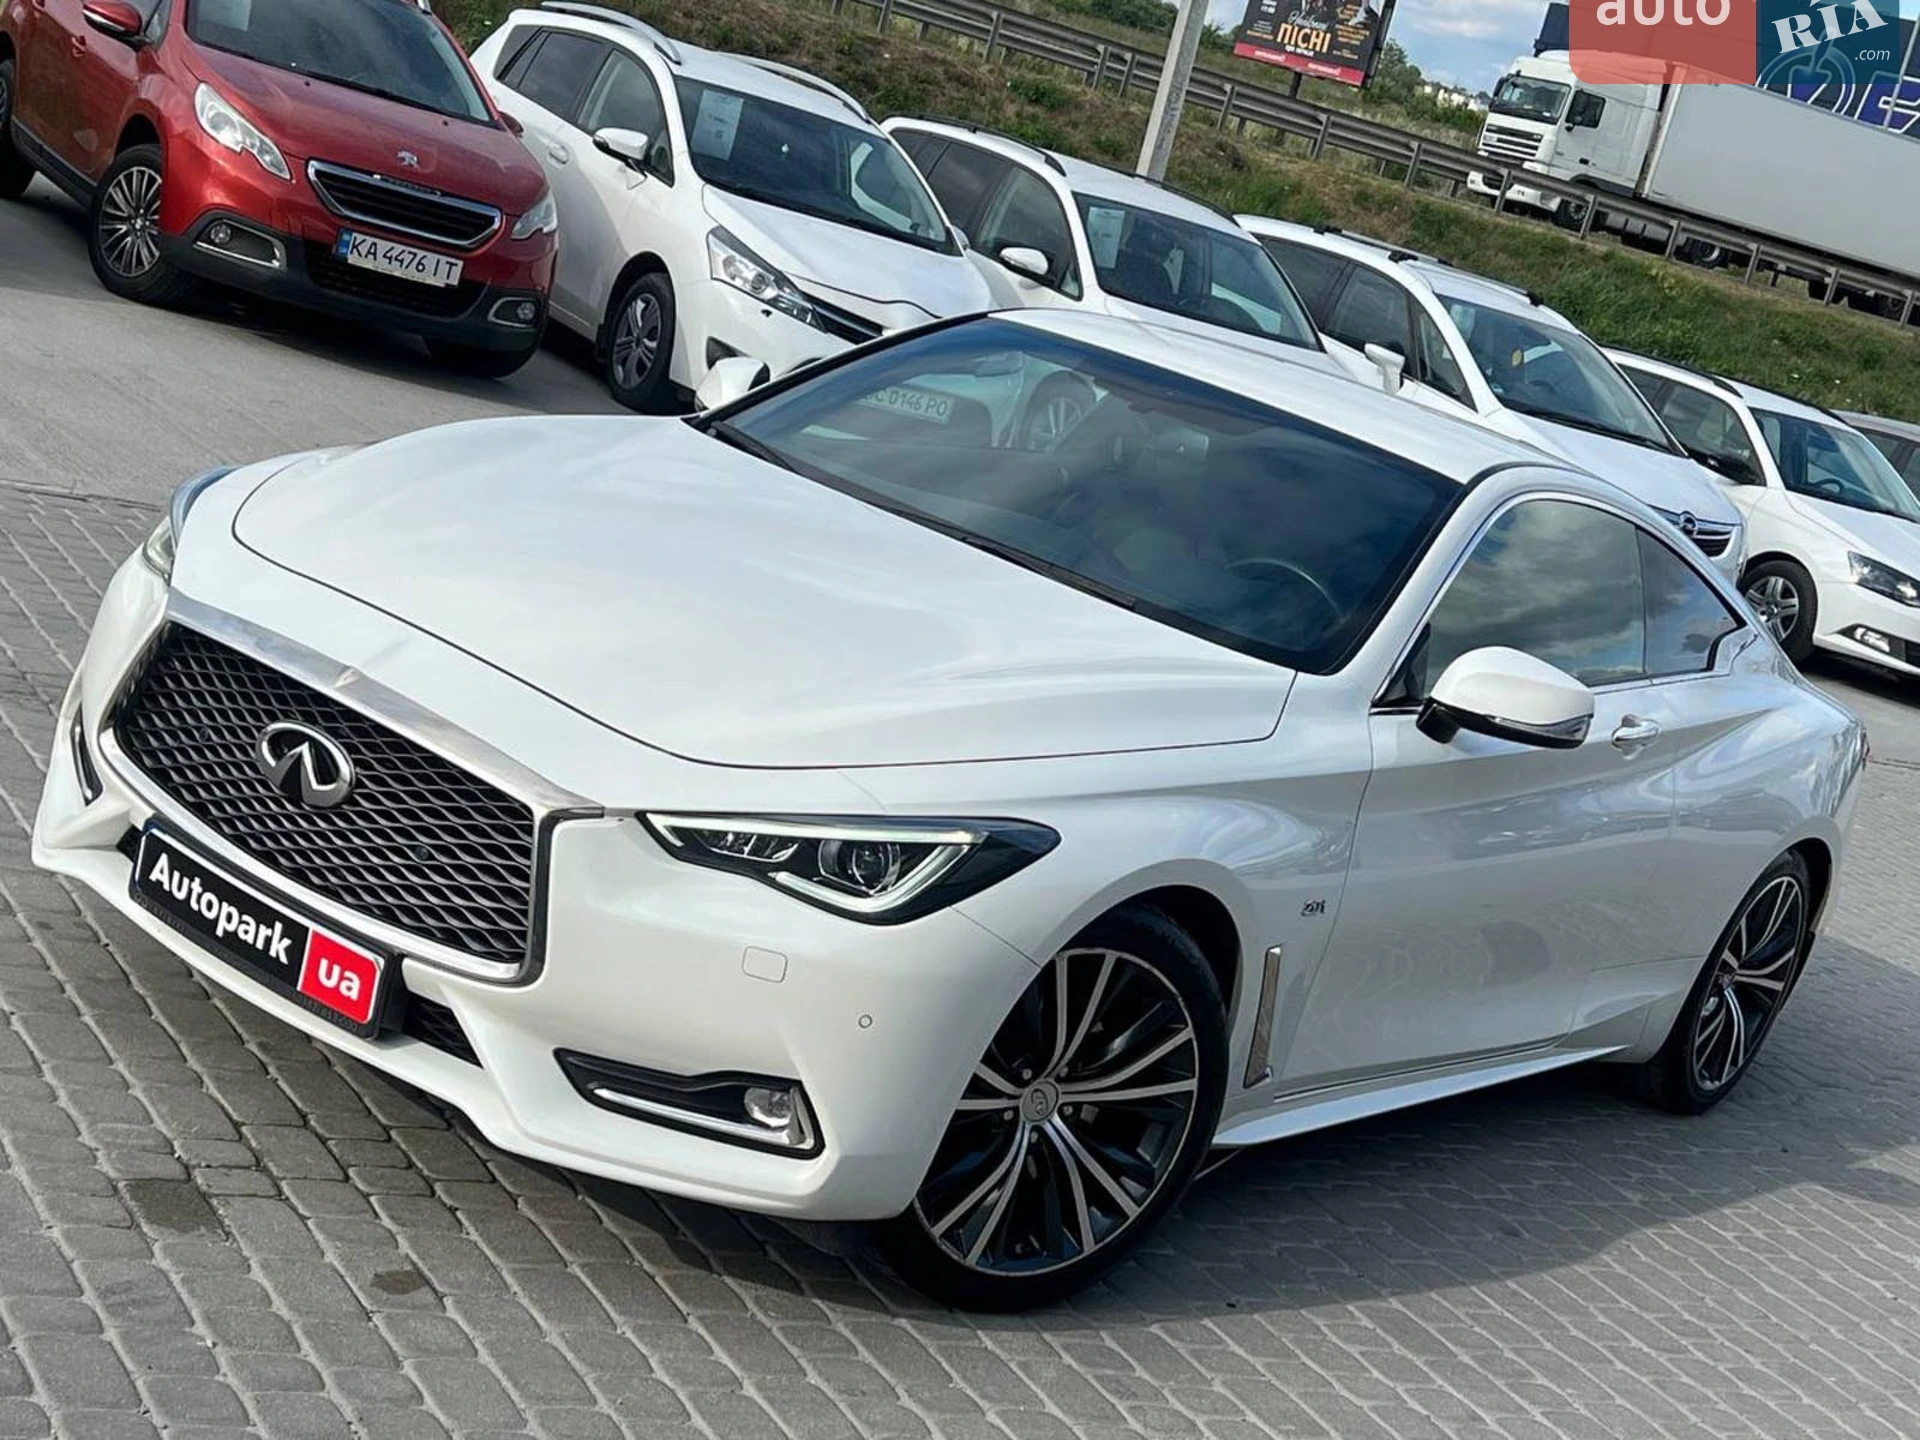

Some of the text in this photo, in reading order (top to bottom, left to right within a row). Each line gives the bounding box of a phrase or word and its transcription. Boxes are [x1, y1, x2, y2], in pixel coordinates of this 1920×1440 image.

[382, 247, 425, 273] 4476
[432, 259, 458, 280] IT
[888, 390, 922, 411] 0146
[149, 852, 293, 965] Autopark
[317, 957, 361, 1001] ua
